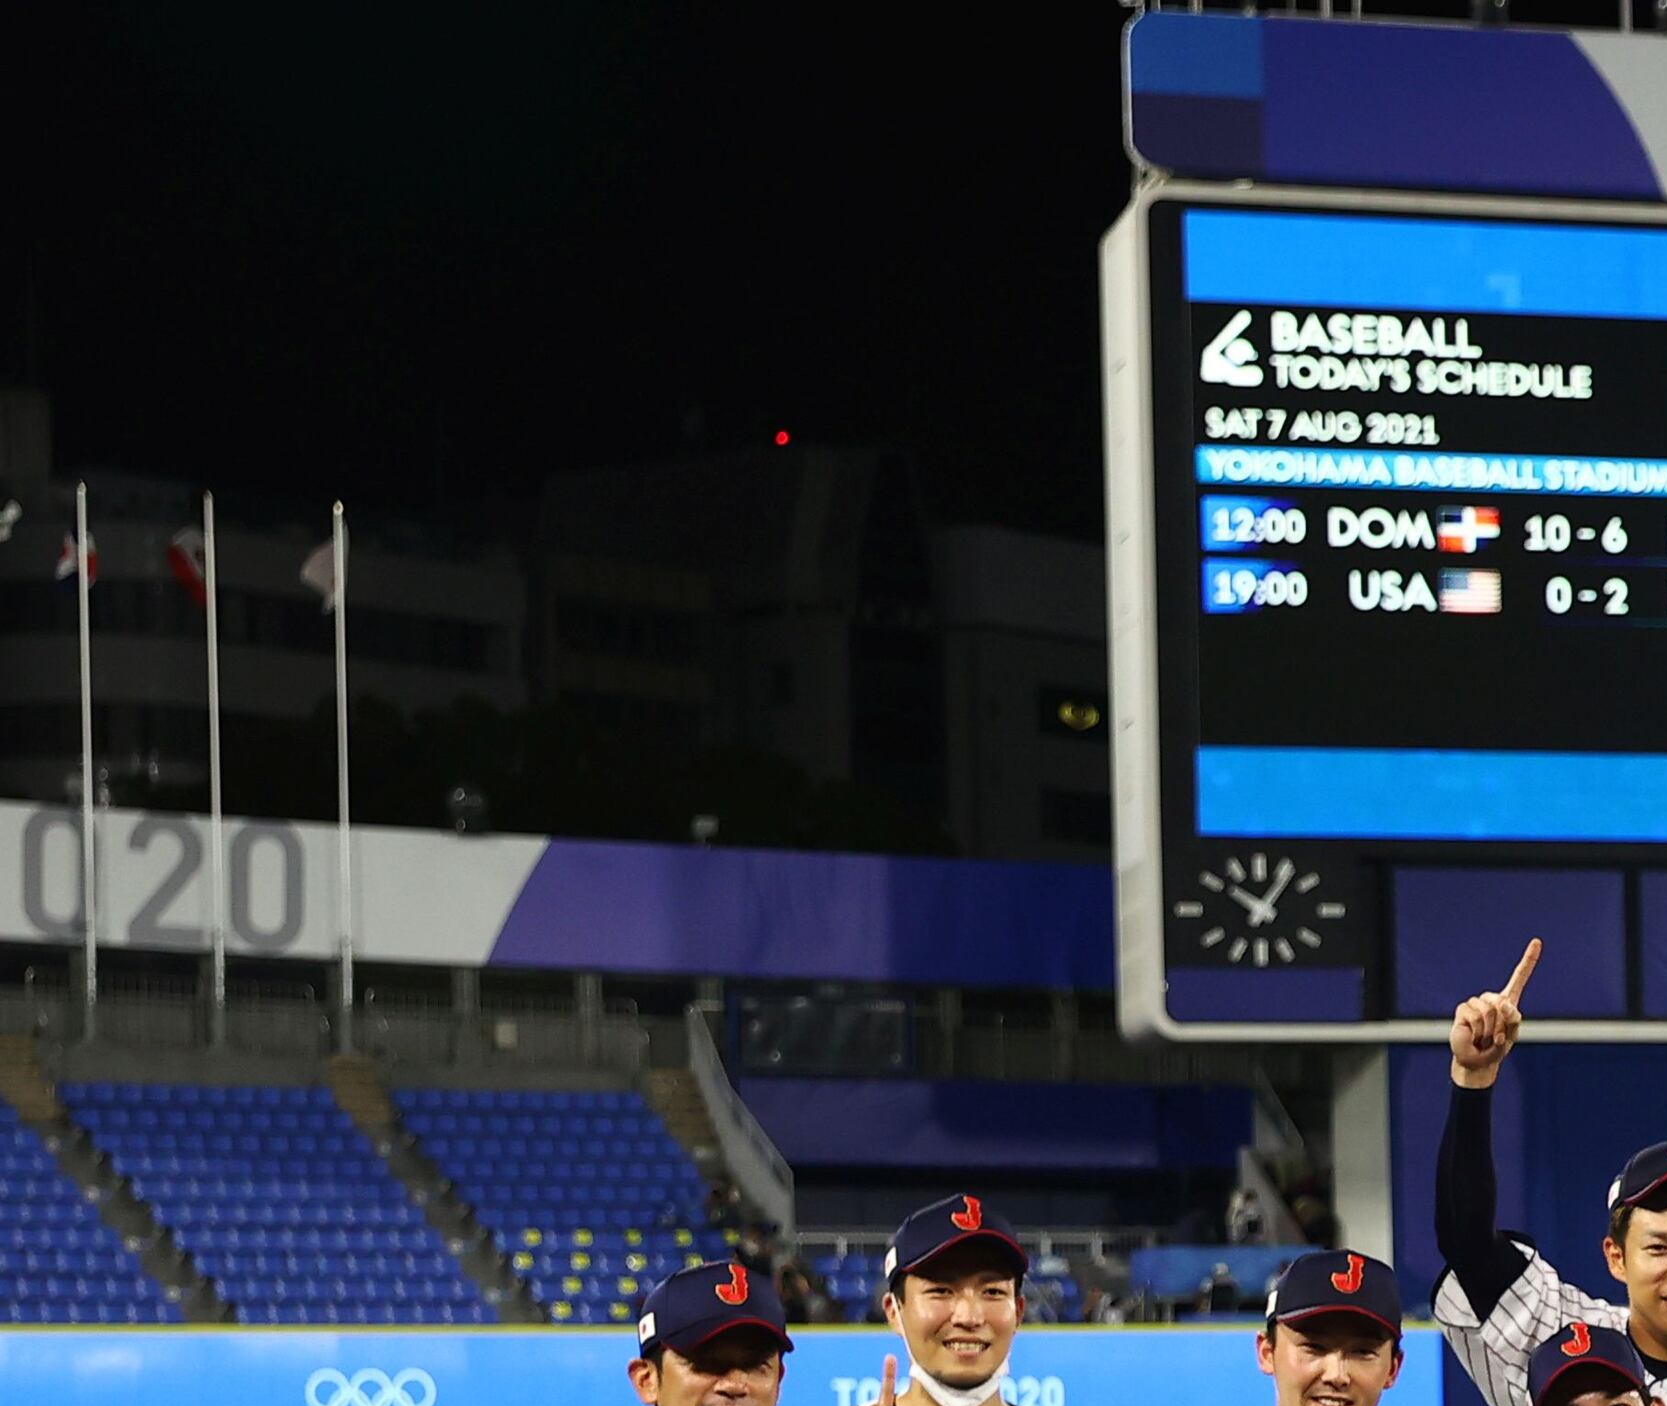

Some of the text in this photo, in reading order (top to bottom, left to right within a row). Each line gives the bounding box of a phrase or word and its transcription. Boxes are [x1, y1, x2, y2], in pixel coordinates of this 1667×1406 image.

[1270, 310, 1482, 359] BASEBALL
[1270, 354, 1592, 399] TODAY'S SCHEDULE
[1204, 406, 1440, 445] SAT 7 AUG 2021
[1206, 449, 1392, 485] YOKOHAMA
[1394, 455, 1542, 490] BASEBALL
[1211, 507, 1307, 544] 12:00
[1327, 506, 1436, 549] DOM
[1524, 513, 1571, 552] 10
[1602, 516, 1629, 554] 6
[1212, 569, 1308, 606] 19:00
[1348, 569, 1438, 612] USA
[1545, 576, 1573, 614] 0
[1603, 577, 1630, 616] 2
[951, 1196, 982, 1231] J
[715, 1263, 749, 1305] J
[1330, 1254, 1365, 1294] J
[1560, 1321, 1592, 1357] J
